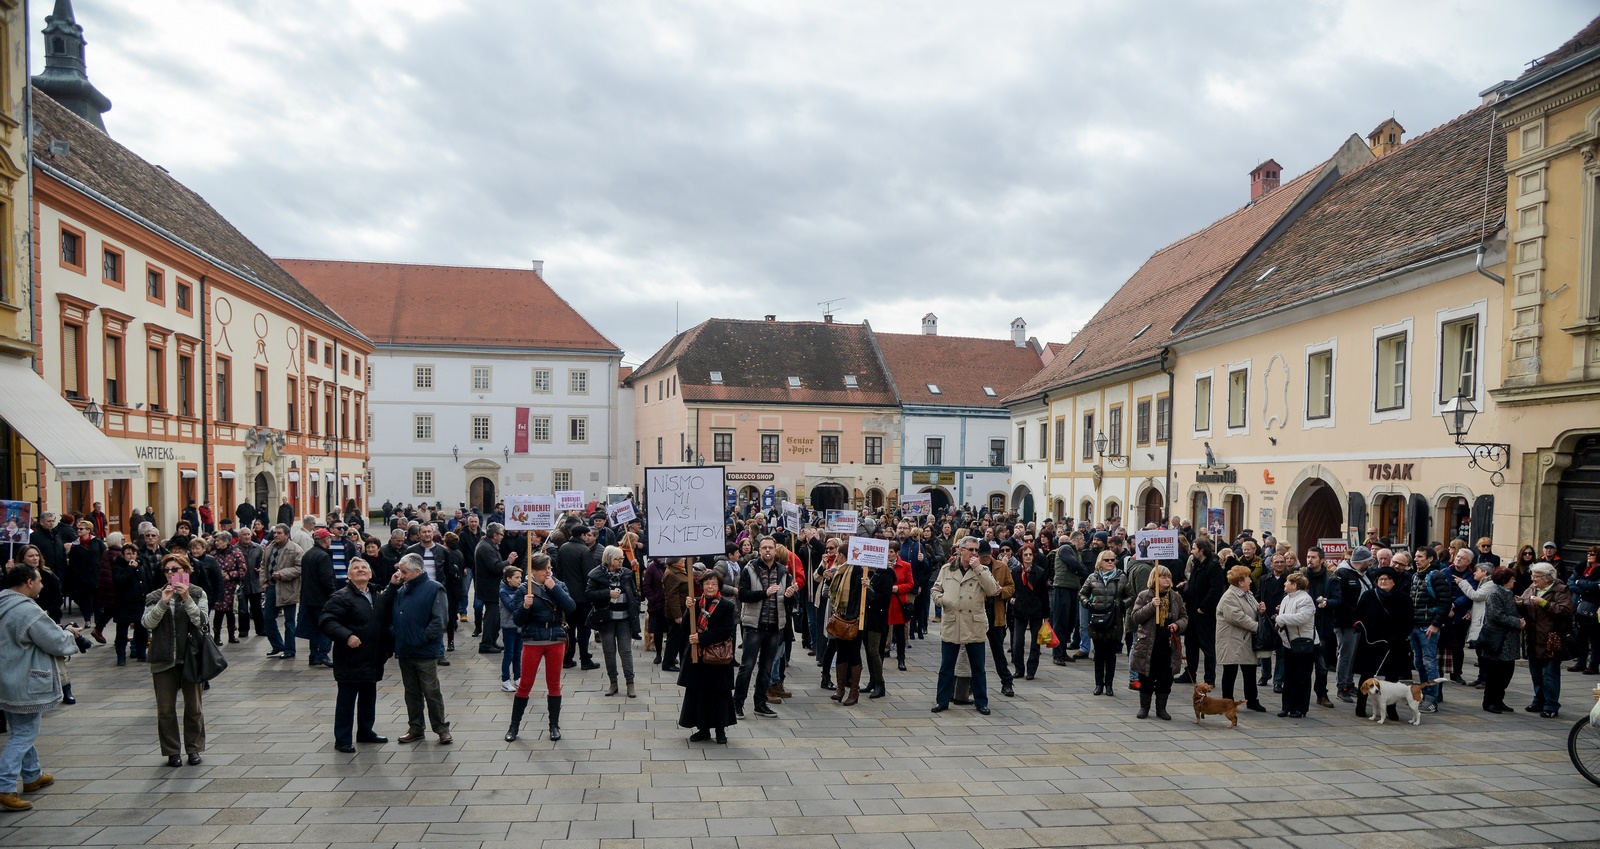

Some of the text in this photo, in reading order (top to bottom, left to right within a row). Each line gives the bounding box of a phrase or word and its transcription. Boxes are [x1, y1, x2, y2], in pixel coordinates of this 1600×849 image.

[786, 436, 814, 445] Centar
[135, 446, 174, 461] VARTEKS
[1368, 463, 1414, 480] TISAK
[673, 492, 689, 504] MI
[655, 506, 697, 521] VAŠI
